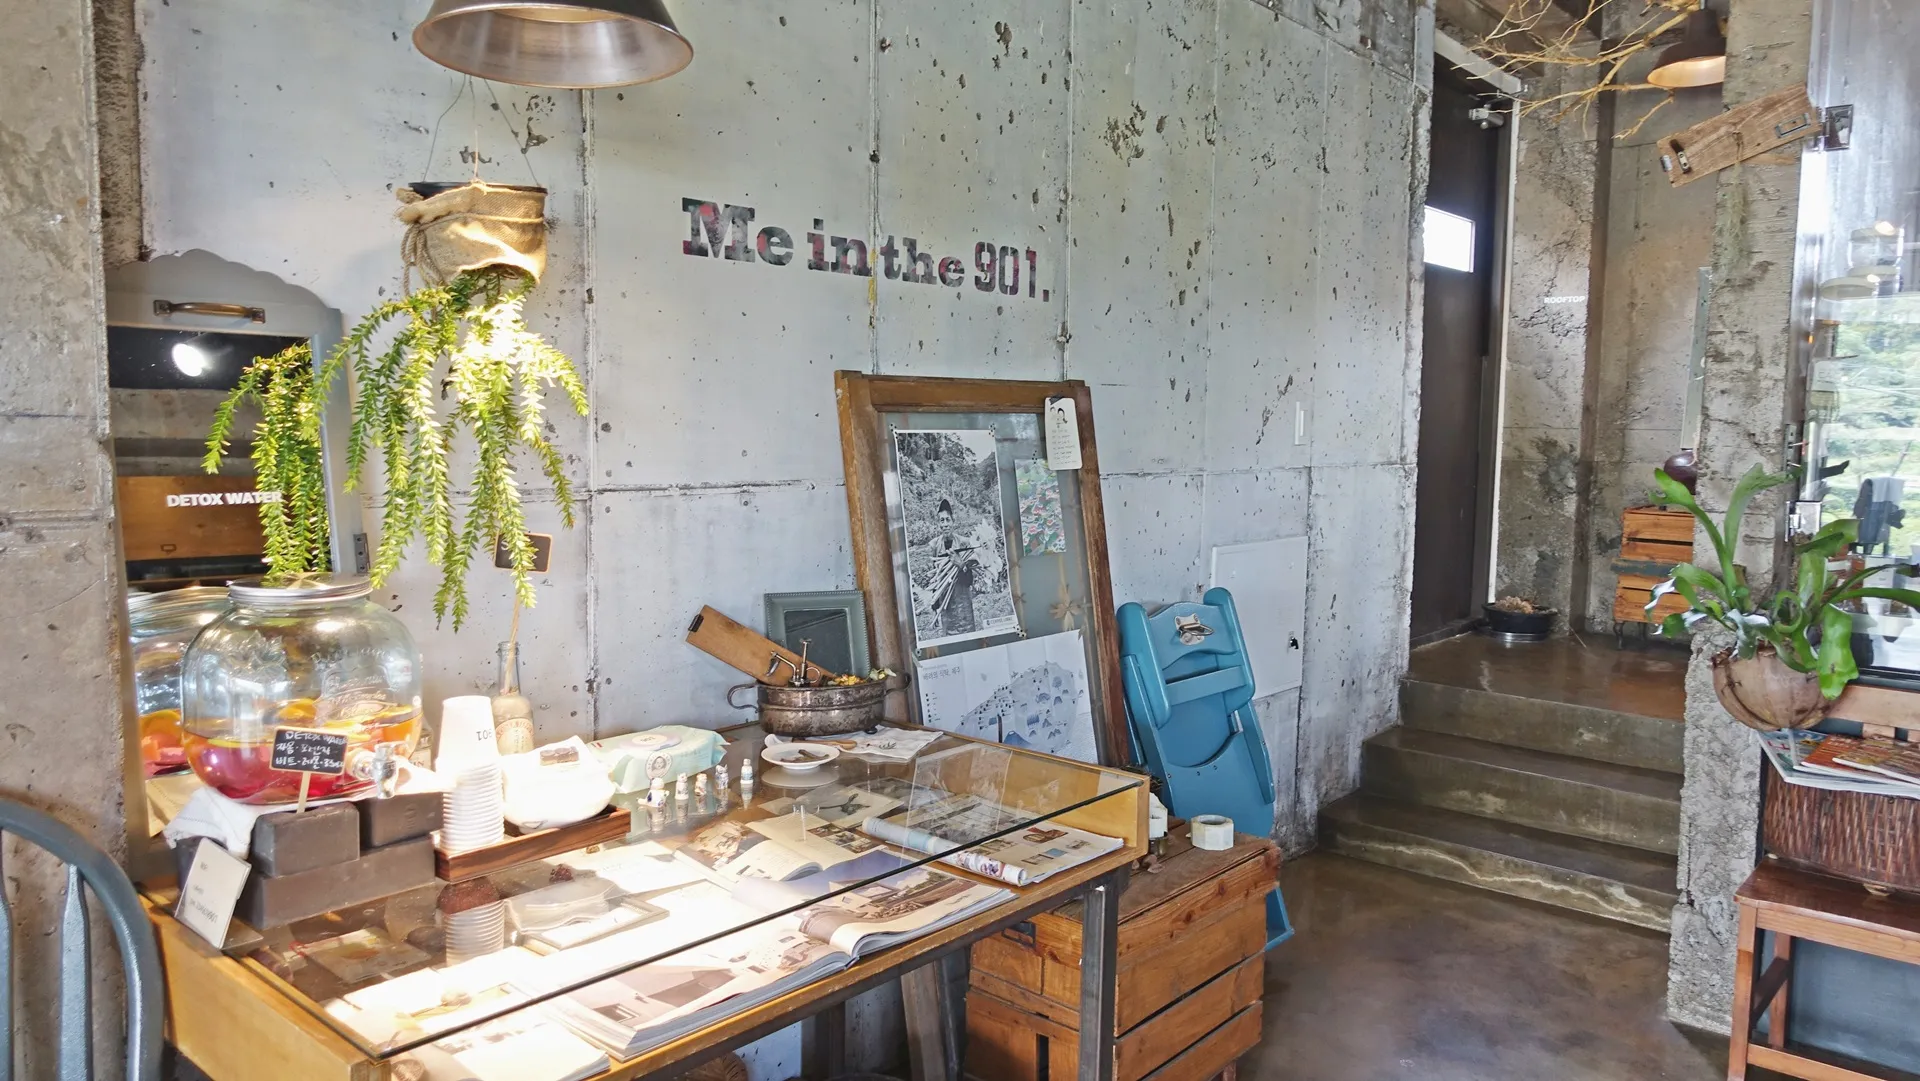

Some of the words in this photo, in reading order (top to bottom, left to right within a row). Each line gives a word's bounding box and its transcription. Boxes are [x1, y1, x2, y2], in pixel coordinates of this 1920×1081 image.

[682, 197, 794, 266] Me
[807, 218, 872, 277] in
[880, 234, 965, 288] the
[975, 242, 1050, 303] 901.
[1544, 295, 1586, 304] ROOFTOP
[166, 493, 224, 507] DETOX
[224, 491, 283, 505] WATER
[285, 730, 321, 741] DETOX
